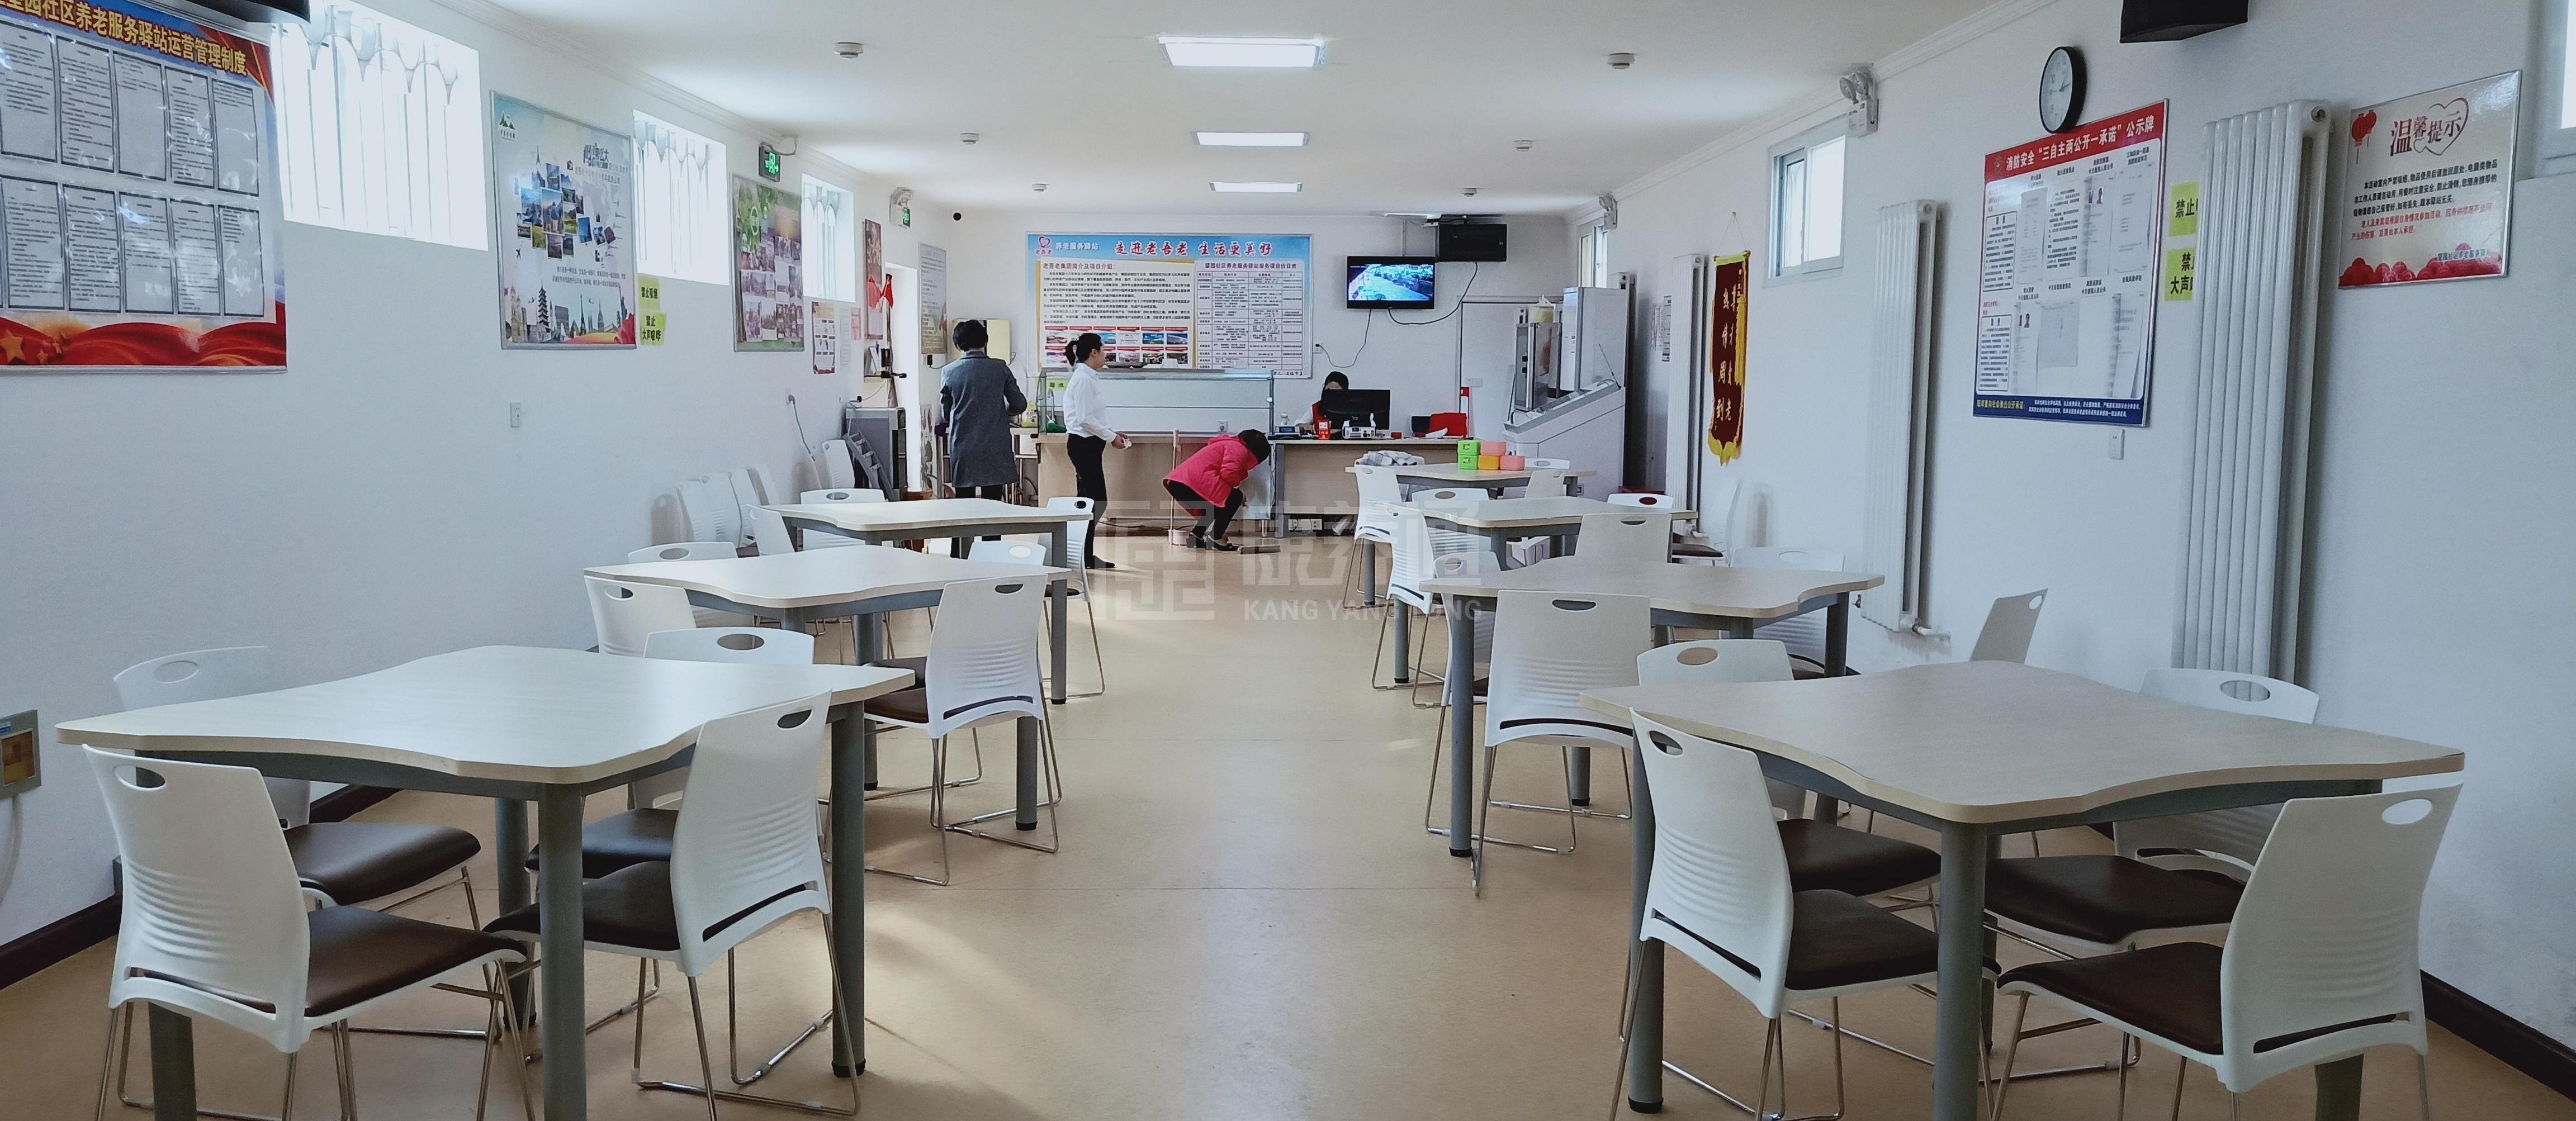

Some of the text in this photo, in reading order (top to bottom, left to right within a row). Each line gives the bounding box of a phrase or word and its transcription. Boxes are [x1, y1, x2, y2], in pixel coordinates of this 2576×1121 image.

[0, 0, 248, 76] 园社区养老服务驿站运营管理制度
[2390, 111, 2462, 157] 温馨提示
[2175, 198, 2199, 218] 禁止
[1116, 240, 1273, 256] 走进老吾老 生活更美好
[2170, 276, 2194, 294] 大声
